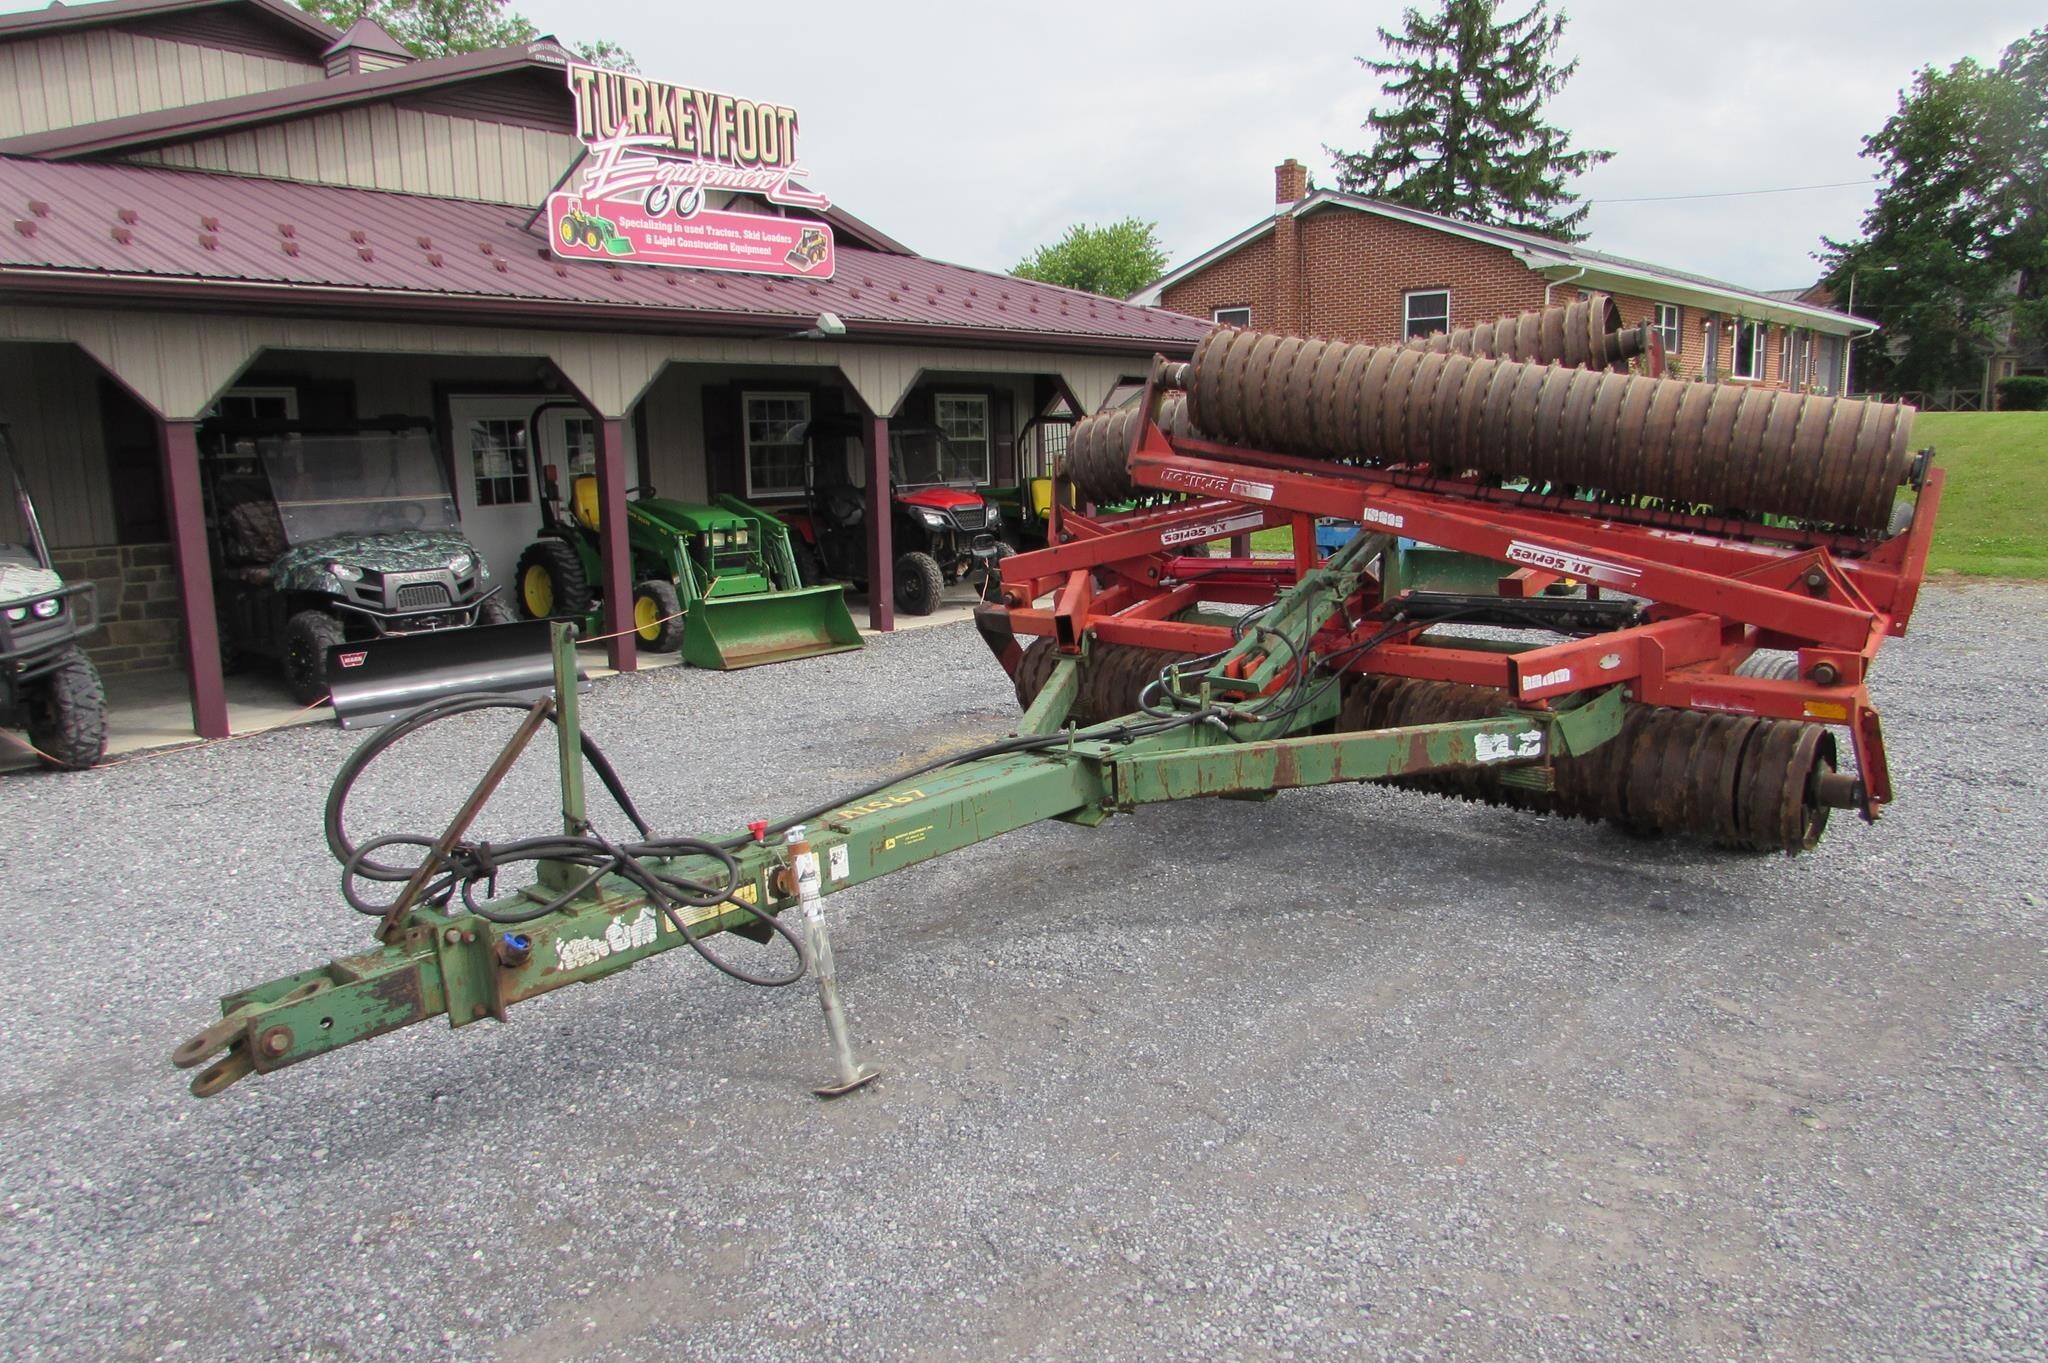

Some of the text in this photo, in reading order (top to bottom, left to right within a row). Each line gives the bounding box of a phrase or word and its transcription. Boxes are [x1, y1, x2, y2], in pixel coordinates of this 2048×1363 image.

[574, 67, 798, 167] TURKEYFOOT
[585, 121, 831, 215] Equipment
[619, 216, 792, 244] Specializing in used Tractors, Skid Loaders
[654, 235, 676, 248] Light
[677, 237, 729, 252] Construction
[730, 242, 772, 256] Equipment
[1164, 522, 1227, 543] XL Series
[1511, 547, 1594, 577] XL Series
